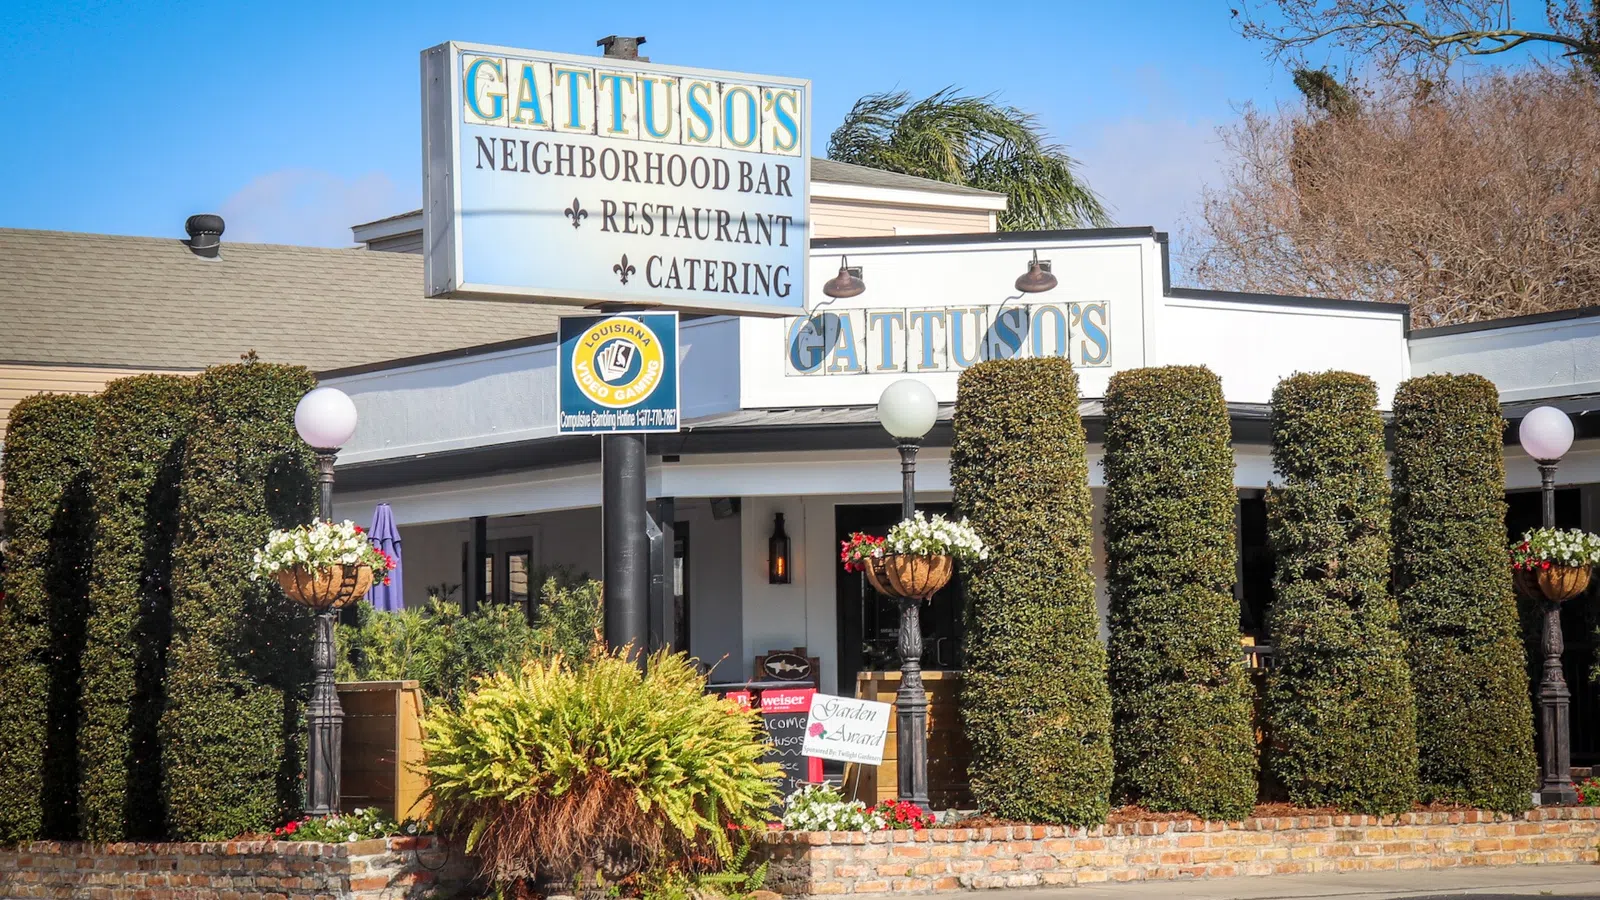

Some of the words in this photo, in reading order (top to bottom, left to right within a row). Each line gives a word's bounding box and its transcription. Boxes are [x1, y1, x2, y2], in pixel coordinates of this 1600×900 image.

[464, 56, 800, 152] GATTUSO'S
[475, 136, 730, 191] NEIGHBORHOOD
[738, 160, 793, 197] BAR
[600, 199, 794, 247] RESTAURANT
[645, 255, 792, 298] CATERING
[585, 324, 651, 348] LOUISIANA
[786, 303, 1109, 374] GATTUSO'S
[576, 360, 609, 398] VIDEO
[614, 360, 660, 400] GAMING
[560, 411, 591, 431] Compulsive
[591, 409, 617, 430] Gambling
[616, 410, 636, 427] Hotline
[812, 698, 877, 721] Garden
[803, 745, 829, 755] Sponsored
[838, 750, 857, 759] Twilight
[826, 724, 885, 747] Award
